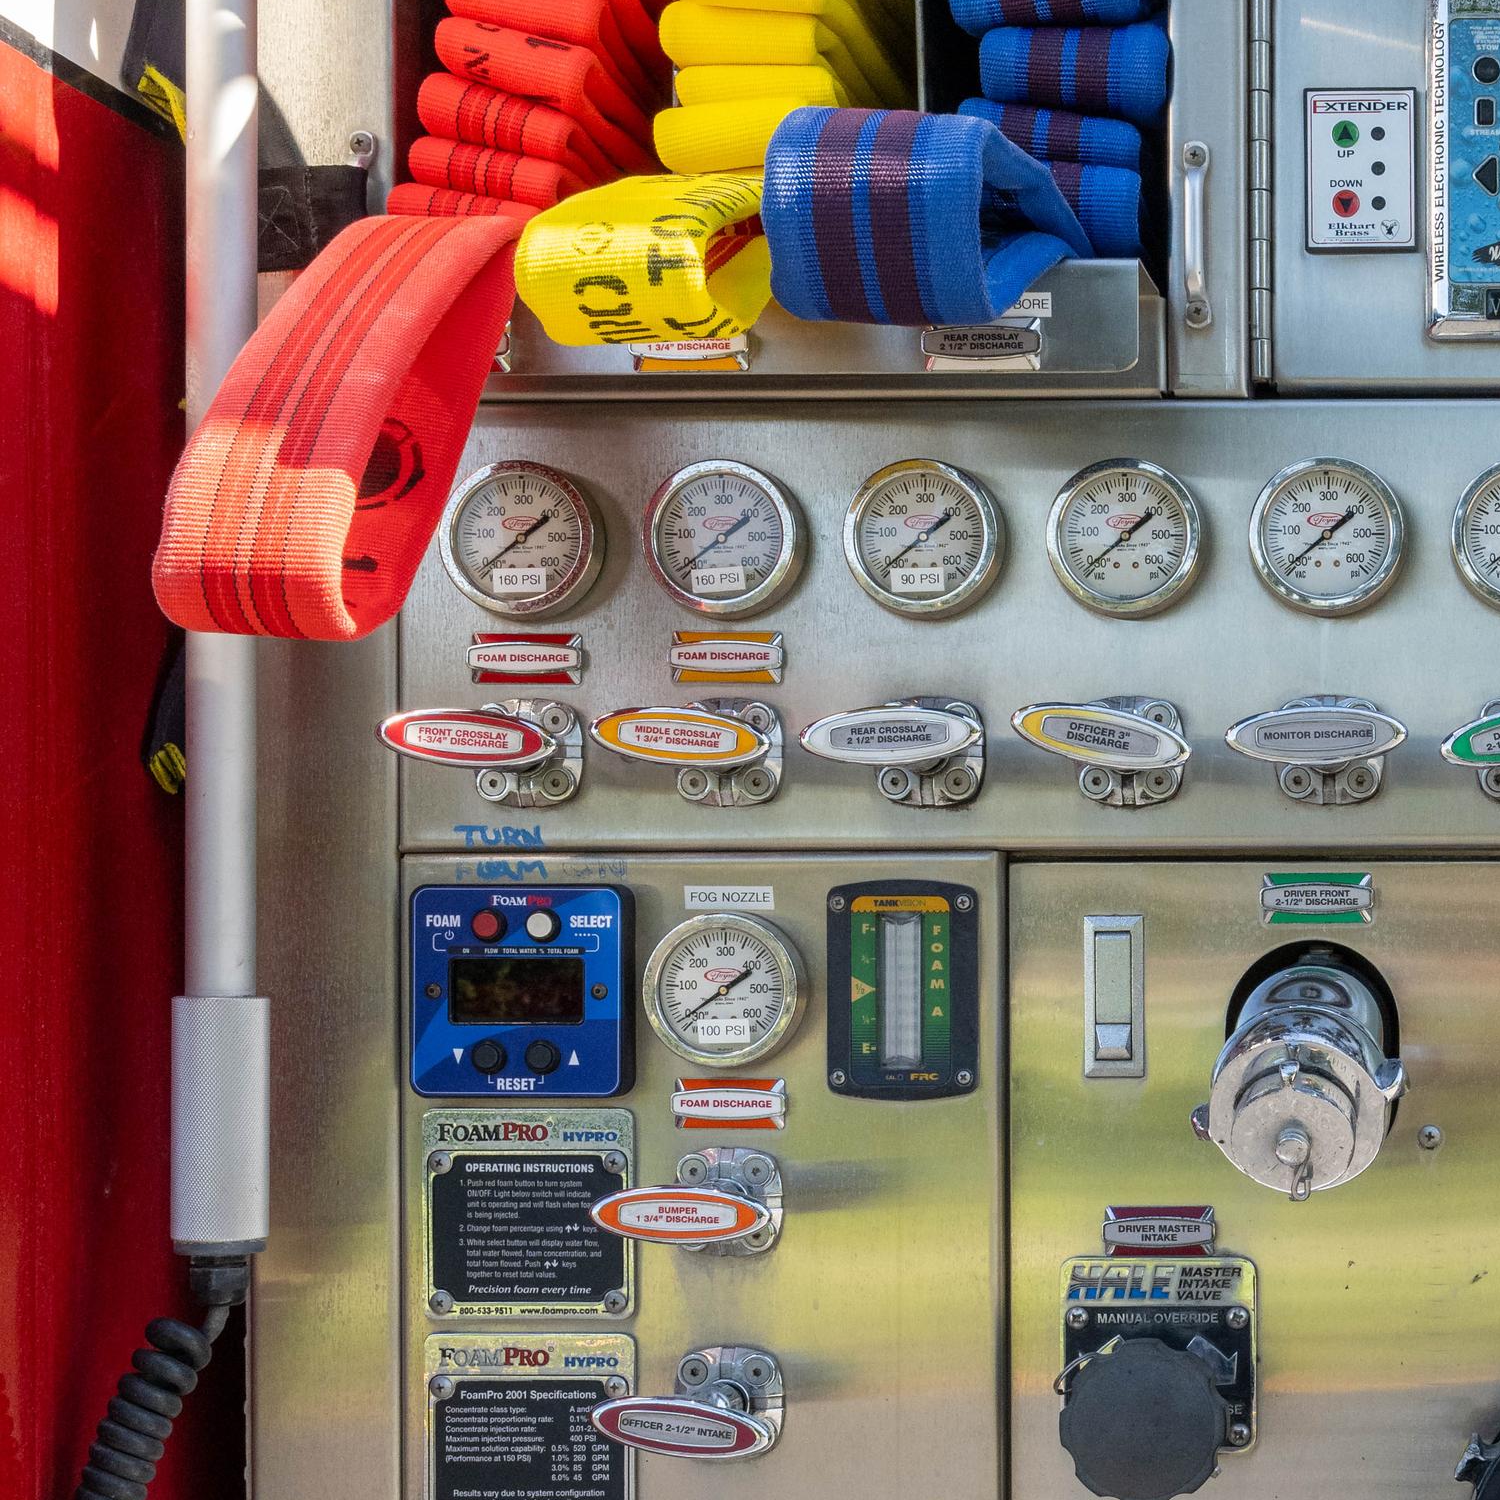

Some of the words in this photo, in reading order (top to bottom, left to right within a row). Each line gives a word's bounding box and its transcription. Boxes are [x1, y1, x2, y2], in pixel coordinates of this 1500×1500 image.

[1434, 21, 1445, 117] TECHNOLOGY
[1314, 100, 1407, 113] EXTENDER
[1338, 150, 1354, 158] UP
[1434, 120, 1445, 208] ELECTRONIC
[1328, 222, 1375, 230] Elkhart
[1434, 213, 1445, 282] WIRELESS
[498, 575, 517, 586] 160
[522, 574, 541, 585] PSI
[901, 574, 916, 585] 90
[919, 573, 940, 585] PSI
[477, 654, 507, 663] FOAM
[510, 654, 569, 663] DISCHARGE
[419, 727, 452, 736] FRONT
[456, 730, 508, 740] CROSSLAY
[850, 727, 877, 736] REAR
[878, 725, 928, 735] CROSSLAY
[1263, 730, 1309, 740] MONITOR
[1312, 729, 1373, 739] DISCHARGE
[418, 736, 447, 744] 1-3/4"
[450, 738, 508, 749] DISCHARGE
[846, 737, 852, 745] 2
[855, 735, 875, 745] 1/2"
[877, 733, 932, 744] DISCHARGE
[454, 825, 544, 848] TURN
[691, 892, 718, 902] FOG
[722, 892, 771, 902] NOZZLE
[426, 915, 460, 927] FOAM
[570, 916, 612, 928] SELECT
[700, 1026, 720, 1036] 100
[725, 1025, 745, 1035] PSI
[497, 1078, 535, 1090] RESET
[466, 1163, 520, 1172] OPERATING
[523, 1164, 594, 1173] INSTRUCTIONS
[642, 1215, 663, 1223] 3/4"
[469, 1285, 510, 1293] Precision
[513, 1285, 539, 1293] foam
[542, 1286, 566, 1295] every
[569, 1285, 591, 1293] time
[1098, 1314, 1150, 1324] MANUAL
[1154, 1313, 1218, 1324] OVERRIDE
[622, 1418, 663, 1430] OFFICER
[665, 1423, 695, 1434] 2-1/2"
[697, 1427, 732, 1439] INTAKE
